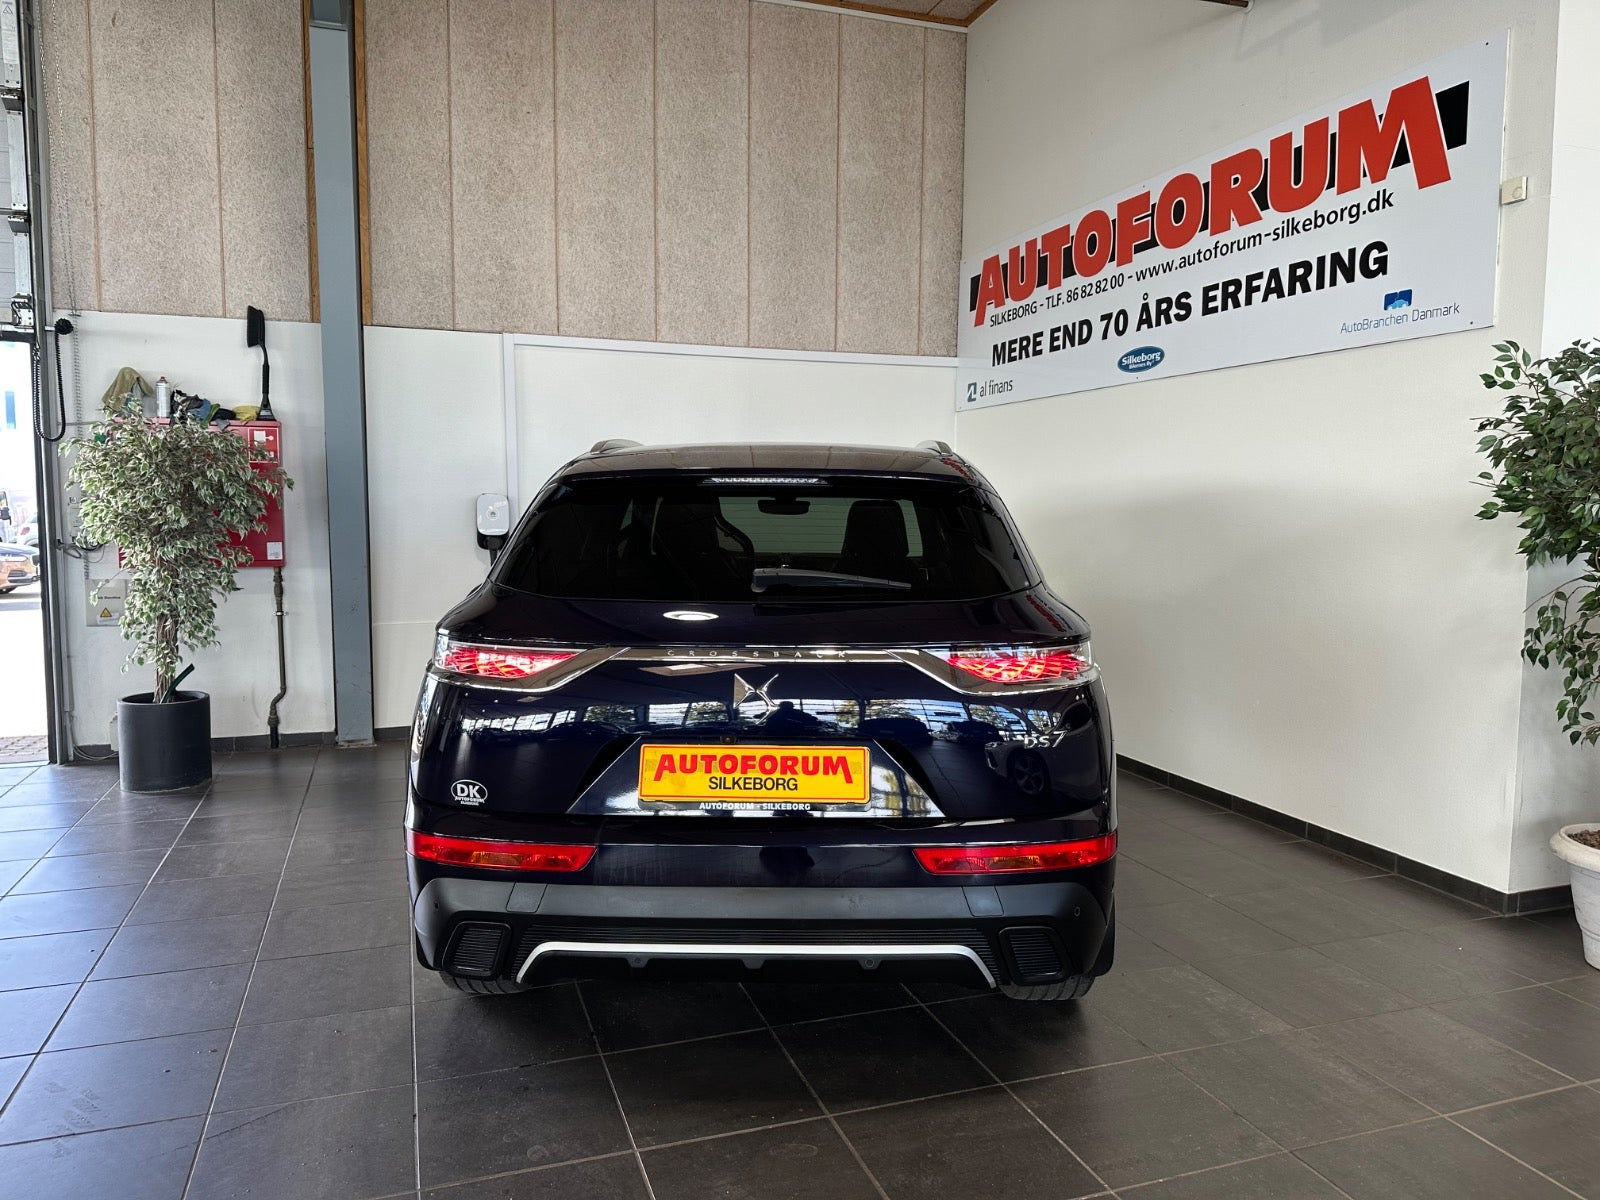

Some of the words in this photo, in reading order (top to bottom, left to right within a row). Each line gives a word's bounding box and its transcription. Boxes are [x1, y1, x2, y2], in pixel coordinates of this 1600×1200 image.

[974, 76, 1451, 327] AUTOFORUM
[990, 301, 1037, 327] SILKEBORG
[1045, 292, 1065, 310] TLF.
[1067, 287, 1079, 303] 86
[1081, 283, 1093, 299] 82
[1095, 279, 1108, 294] 82
[1110, 273, 1124, 290] 00
[1135, 188, 1394, 281] www.autoforum-silkeborg.dk
[992, 331, 1044, 367] MERE
[1049, 318, 1093, 353] END
[1100, 308, 1128, 340] 70
[1136, 291, 1192, 332] ÅRS
[1201, 240, 1389, 317] ERFARING
[1340, 312, 1408, 334] AutoBranchen
[1412, 302, 1460, 322] Danmark
[1121, 352, 1161, 366] Silkeborg
[979, 382, 987, 397] al
[989, 379, 1013, 395] finans
[667, 650, 845, 658] CROSSBACK
[653, 754, 853, 784] AUTOFORUM
[457, 784, 481, 799] DK
[708, 776, 798, 791] SILKEBORG
[699, 802, 754, 811] AUTOFORUM
[762, 802, 811, 811] SILKEBORG
